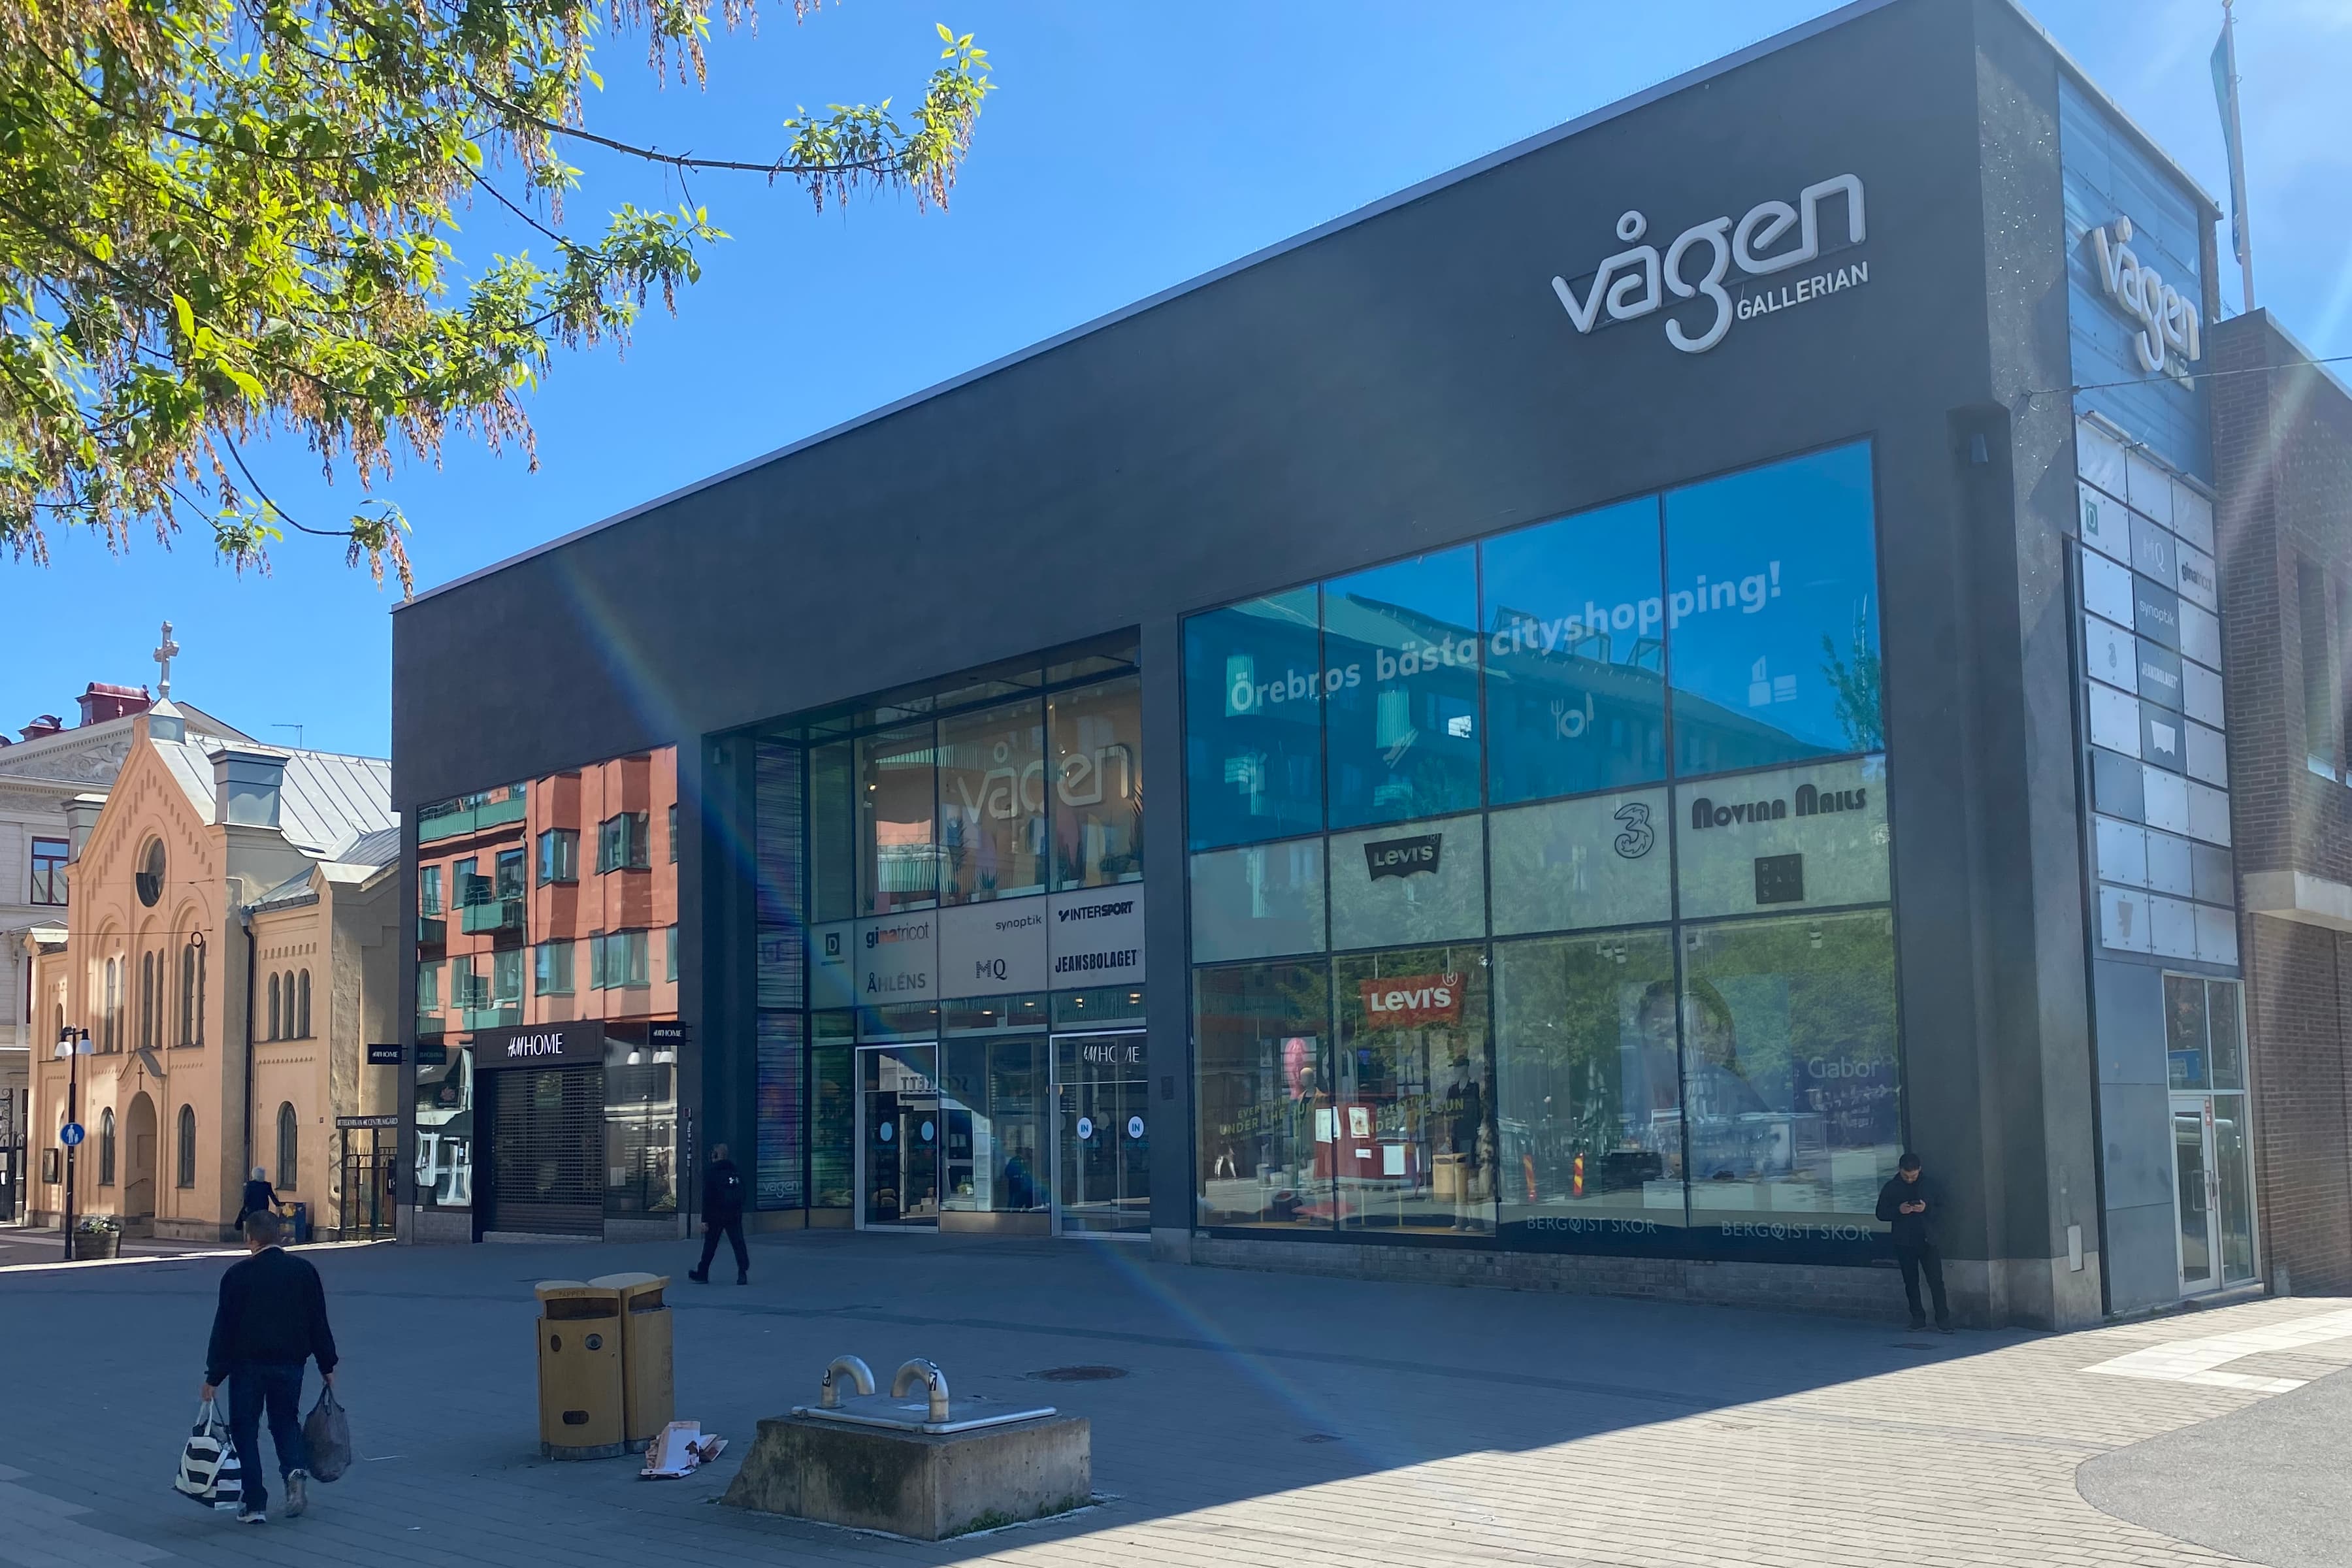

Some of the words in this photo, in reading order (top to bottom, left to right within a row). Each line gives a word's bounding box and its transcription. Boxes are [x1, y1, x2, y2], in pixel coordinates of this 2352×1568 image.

[1552, 173, 1866, 353] vågen
[1737, 261, 1869, 320] GALLERIAN
[2093, 215, 2200, 372] vågen
[2143, 533, 2164, 573] MQ
[2140, 600, 2174, 627] synoptik
[1230, 660, 1361, 711] Örebros
[1376, 634, 1479, 681] bästa
[1491, 560, 1781, 655] cityshopping!
[1614, 802, 1654, 858] 3
[1071, 901, 1134, 921] INTERSPORT
[996, 915, 1041, 931] synoptik
[976, 958, 1007, 980] MQ
[1055, 949, 1137, 973] JEANSBOLAGET
[867, 972, 926, 993] ÅHLÉNS
[524, 1033, 563, 1056] HOME
[1808, 1056, 1880, 1078] Gabor
[1438, 1098, 1463, 1113] SUN
[1081, 1124, 1088, 1132] IN
[1132, 1123, 1140, 1132] IN
[1219, 1117, 1258, 1135] UNDER
[1611, 1218, 1657, 1235] SKOR
[1821, 1224, 1873, 1242] SKOR
